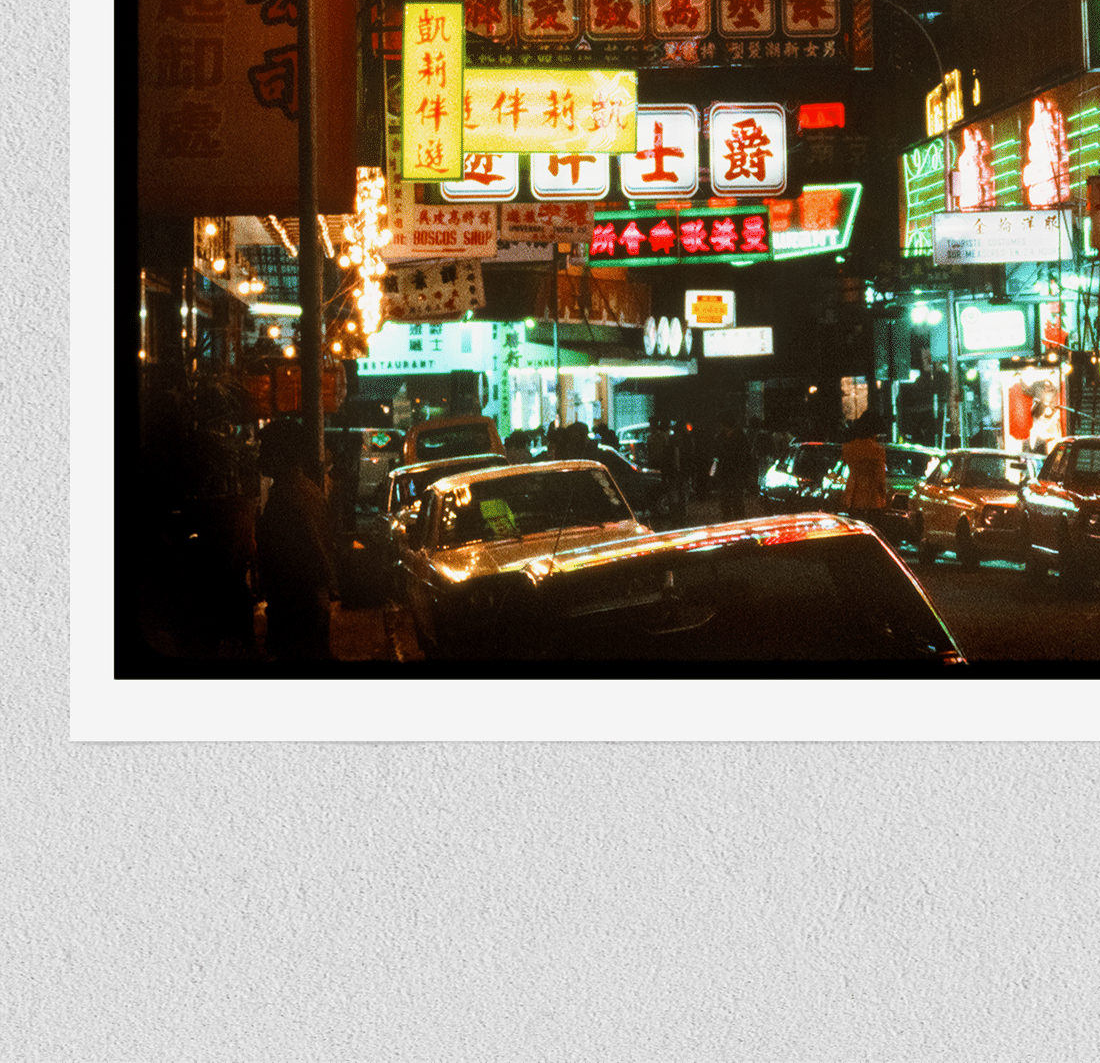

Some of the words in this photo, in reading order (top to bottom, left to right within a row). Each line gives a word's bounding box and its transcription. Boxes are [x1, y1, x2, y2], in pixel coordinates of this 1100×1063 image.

[412, 230, 457, 246] BOSCOS
[463, 229, 493, 246] SHOP
[946, 249, 962, 260] SUR
